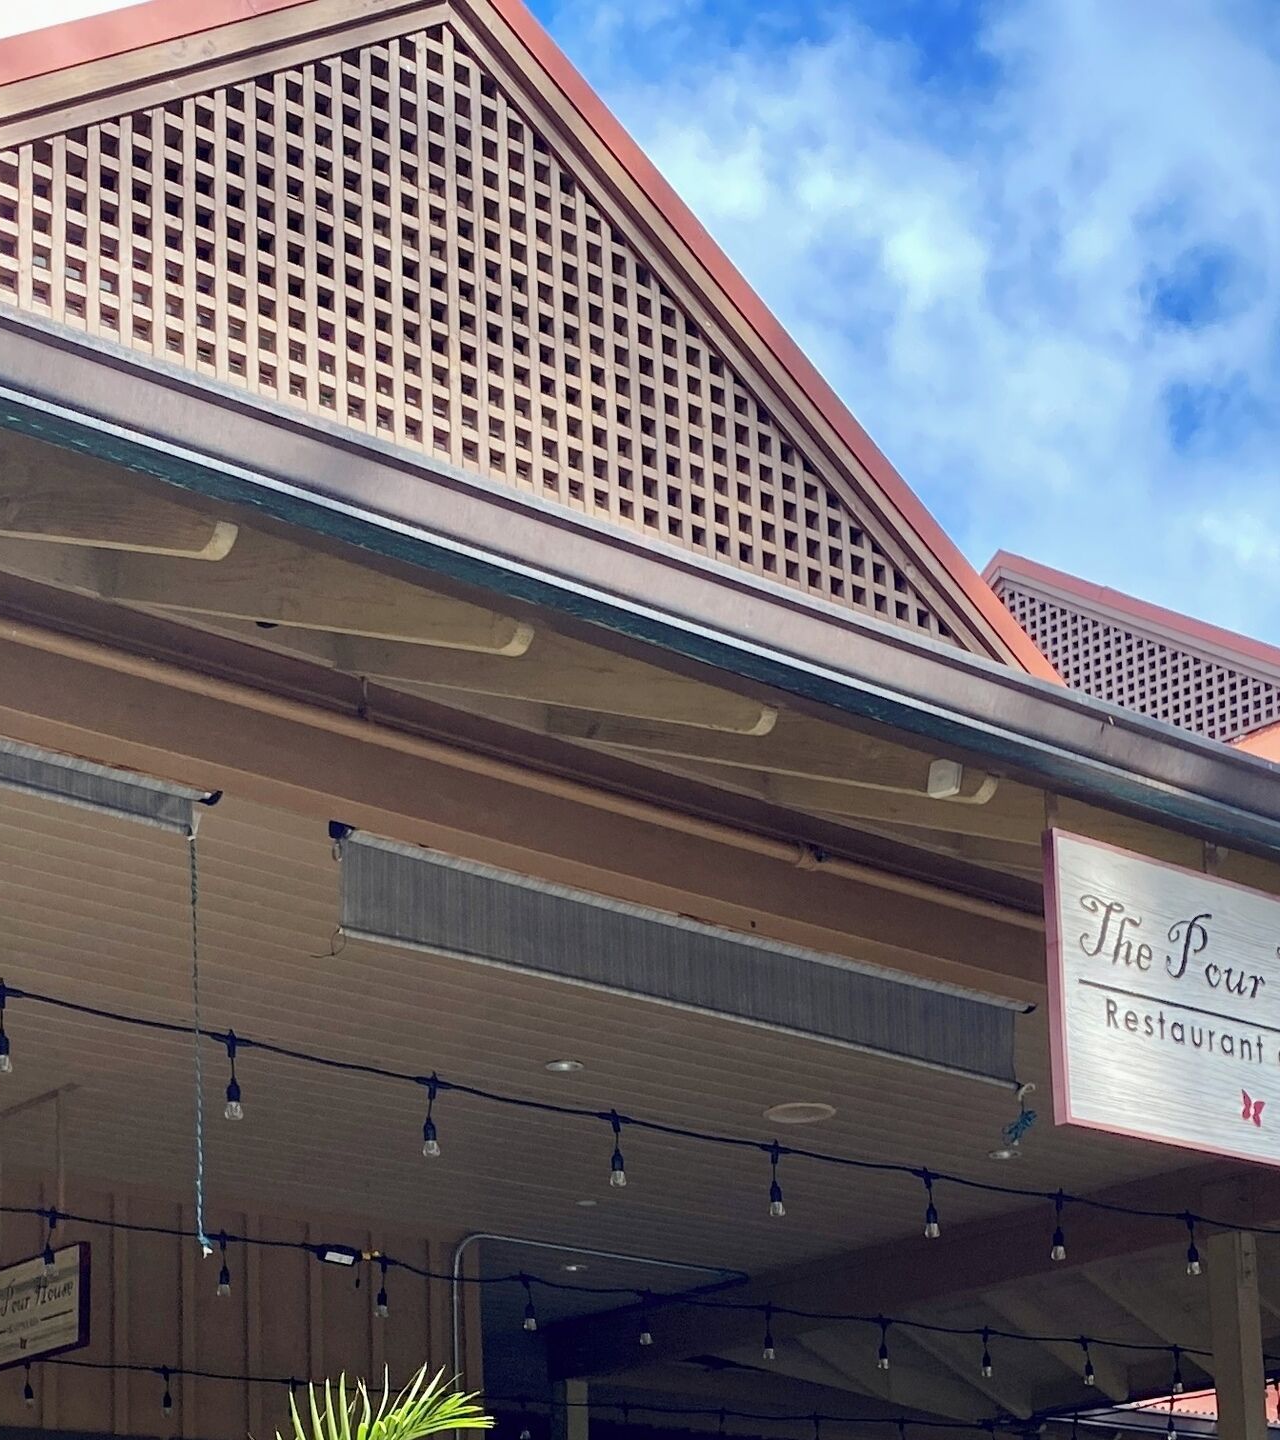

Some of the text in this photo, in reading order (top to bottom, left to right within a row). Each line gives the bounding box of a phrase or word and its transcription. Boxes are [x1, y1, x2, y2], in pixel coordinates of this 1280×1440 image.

[1079, 893, 1153, 972] The
[1165, 913, 1266, 999] Pour
[1105, 997, 1264, 1064] Restaurant
